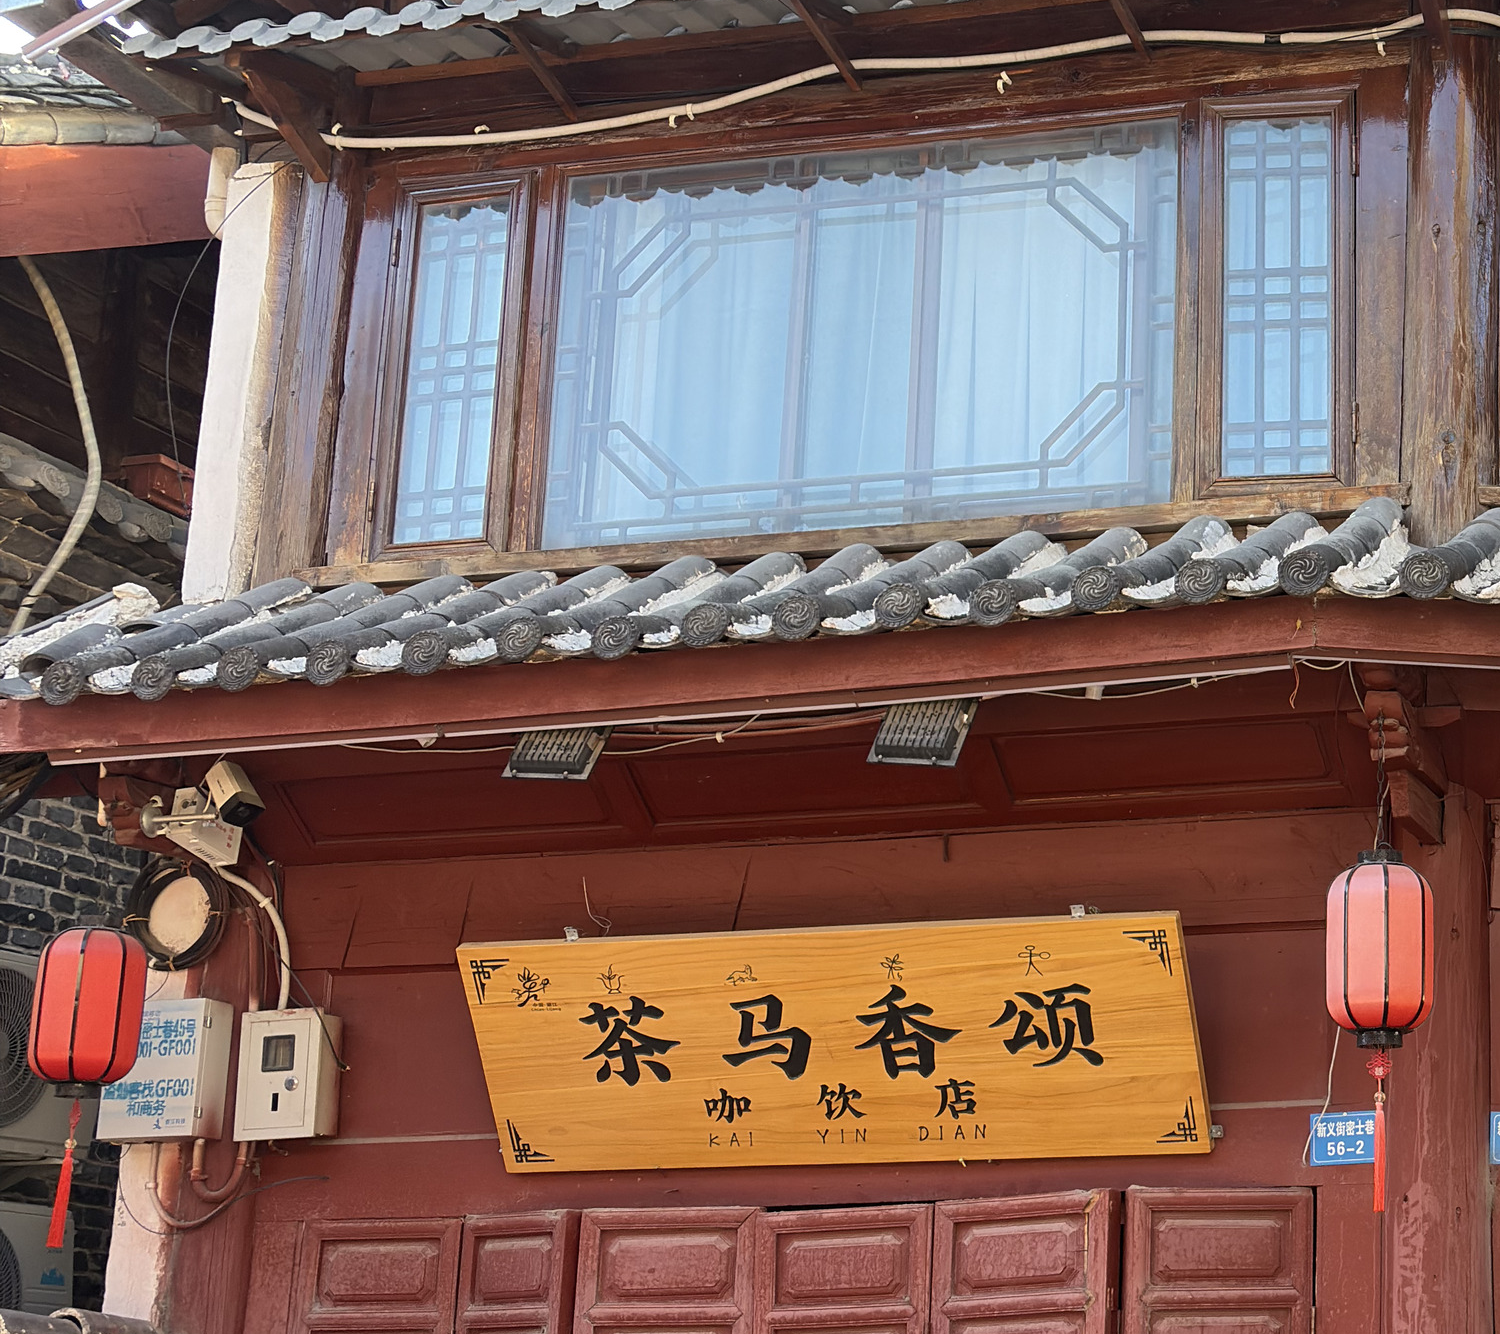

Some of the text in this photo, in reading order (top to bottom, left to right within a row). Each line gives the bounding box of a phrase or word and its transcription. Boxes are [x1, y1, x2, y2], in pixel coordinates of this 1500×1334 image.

[578, 982, 1104, 1087] 茶马香颂
[705, 1078, 978, 1124] 咖饮店
[708, 1124, 987, 1148] KAI YIN DIAN
[1316, 1119, 1375, 1138] 新义街密士巷
[1327, 1140, 1365, 1156] 56-2
